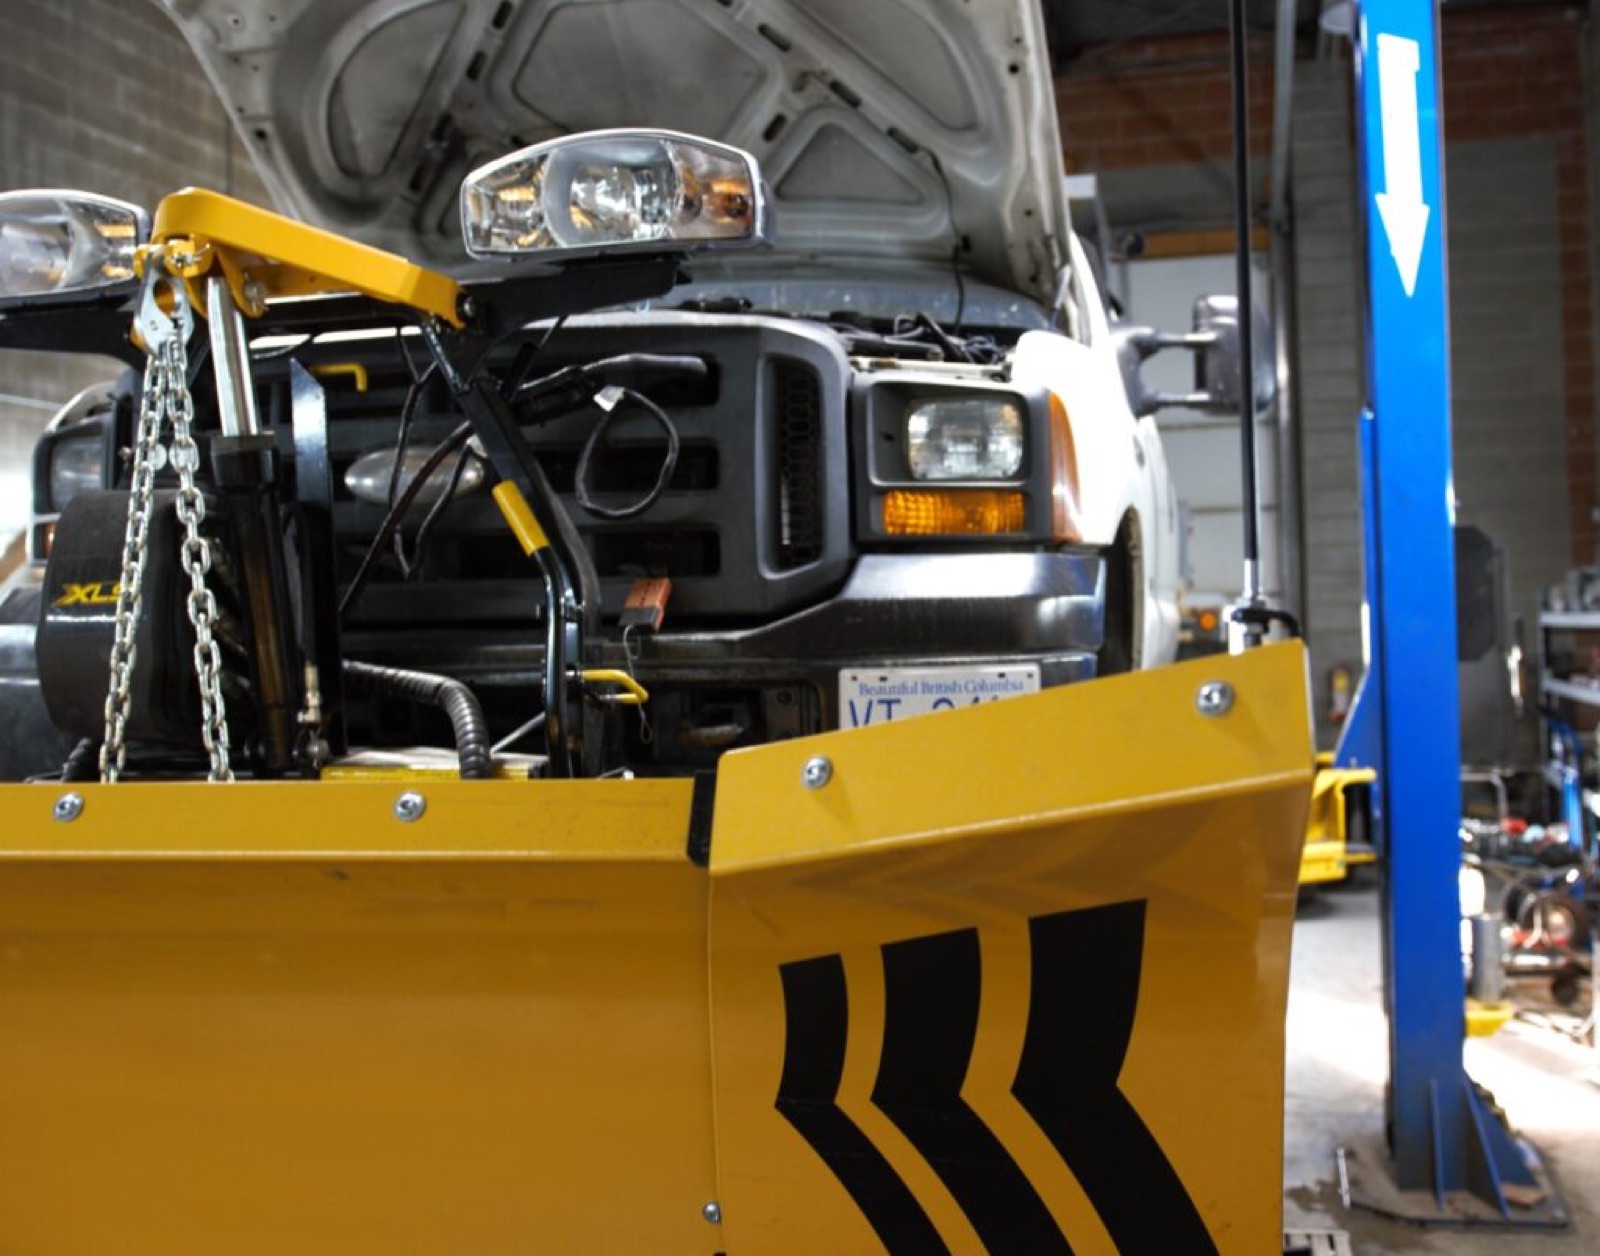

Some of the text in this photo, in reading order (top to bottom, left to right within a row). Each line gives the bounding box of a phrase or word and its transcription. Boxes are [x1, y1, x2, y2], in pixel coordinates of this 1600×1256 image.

[859, 678, 1024, 696] Beautiful British Columbia
